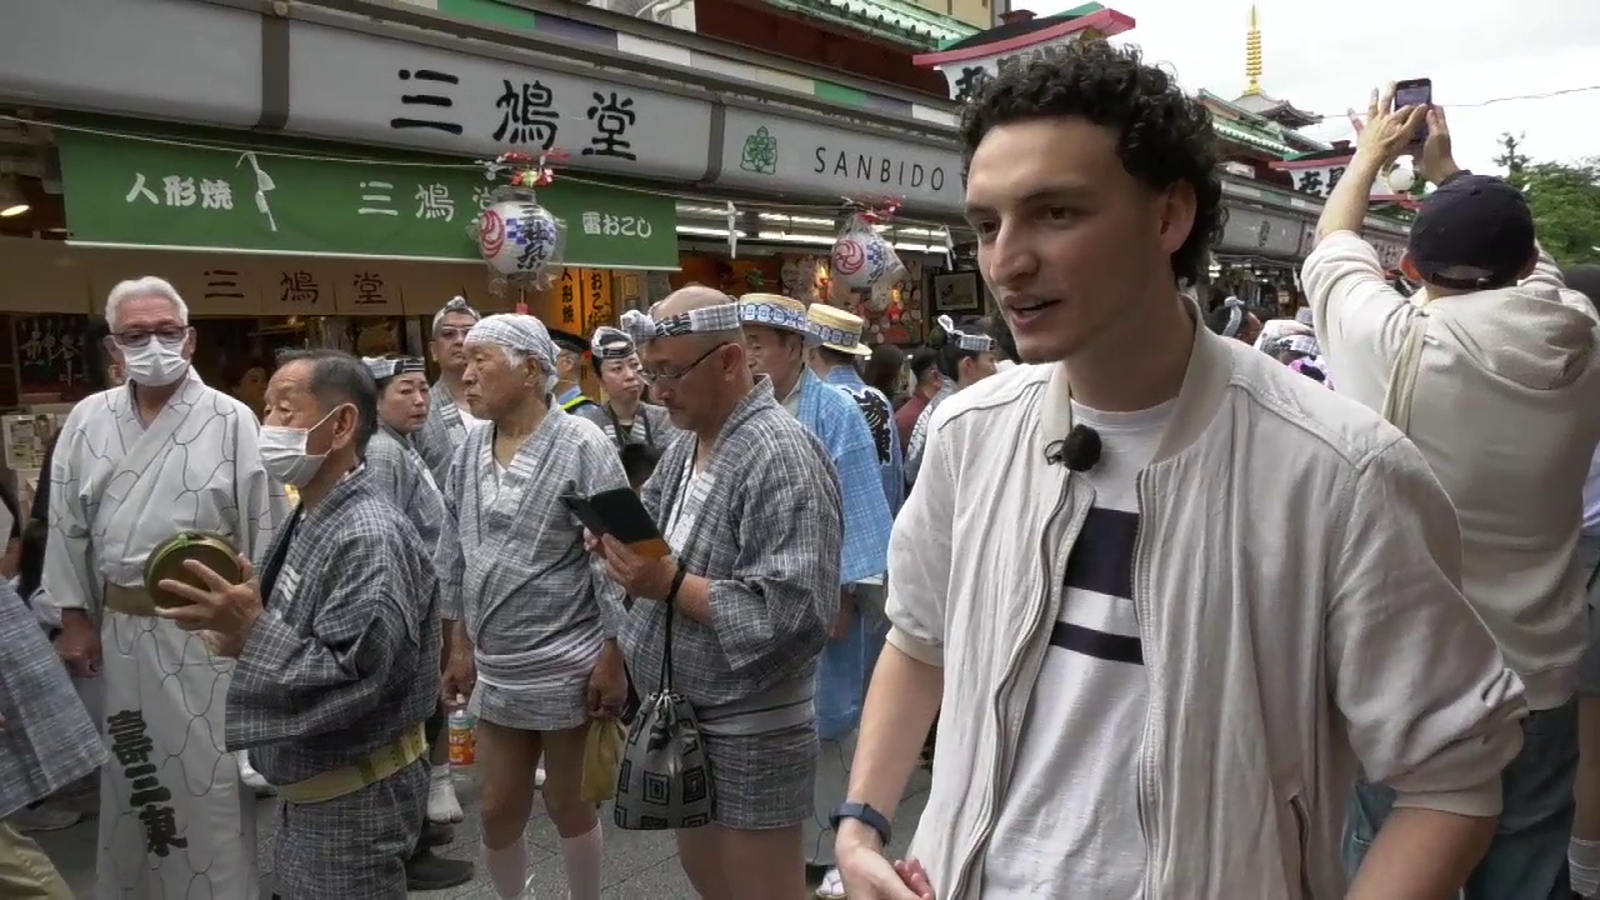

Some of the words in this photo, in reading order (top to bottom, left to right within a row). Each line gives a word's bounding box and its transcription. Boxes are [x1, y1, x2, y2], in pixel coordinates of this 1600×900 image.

[390, 69, 637, 161] 三鳩堂
[815, 146, 944, 191] SANBIDO
[126, 172, 234, 210] 人形焼
[582, 211, 652, 237] 雷おこし
[203, 269, 388, 305] 三鳩堂
